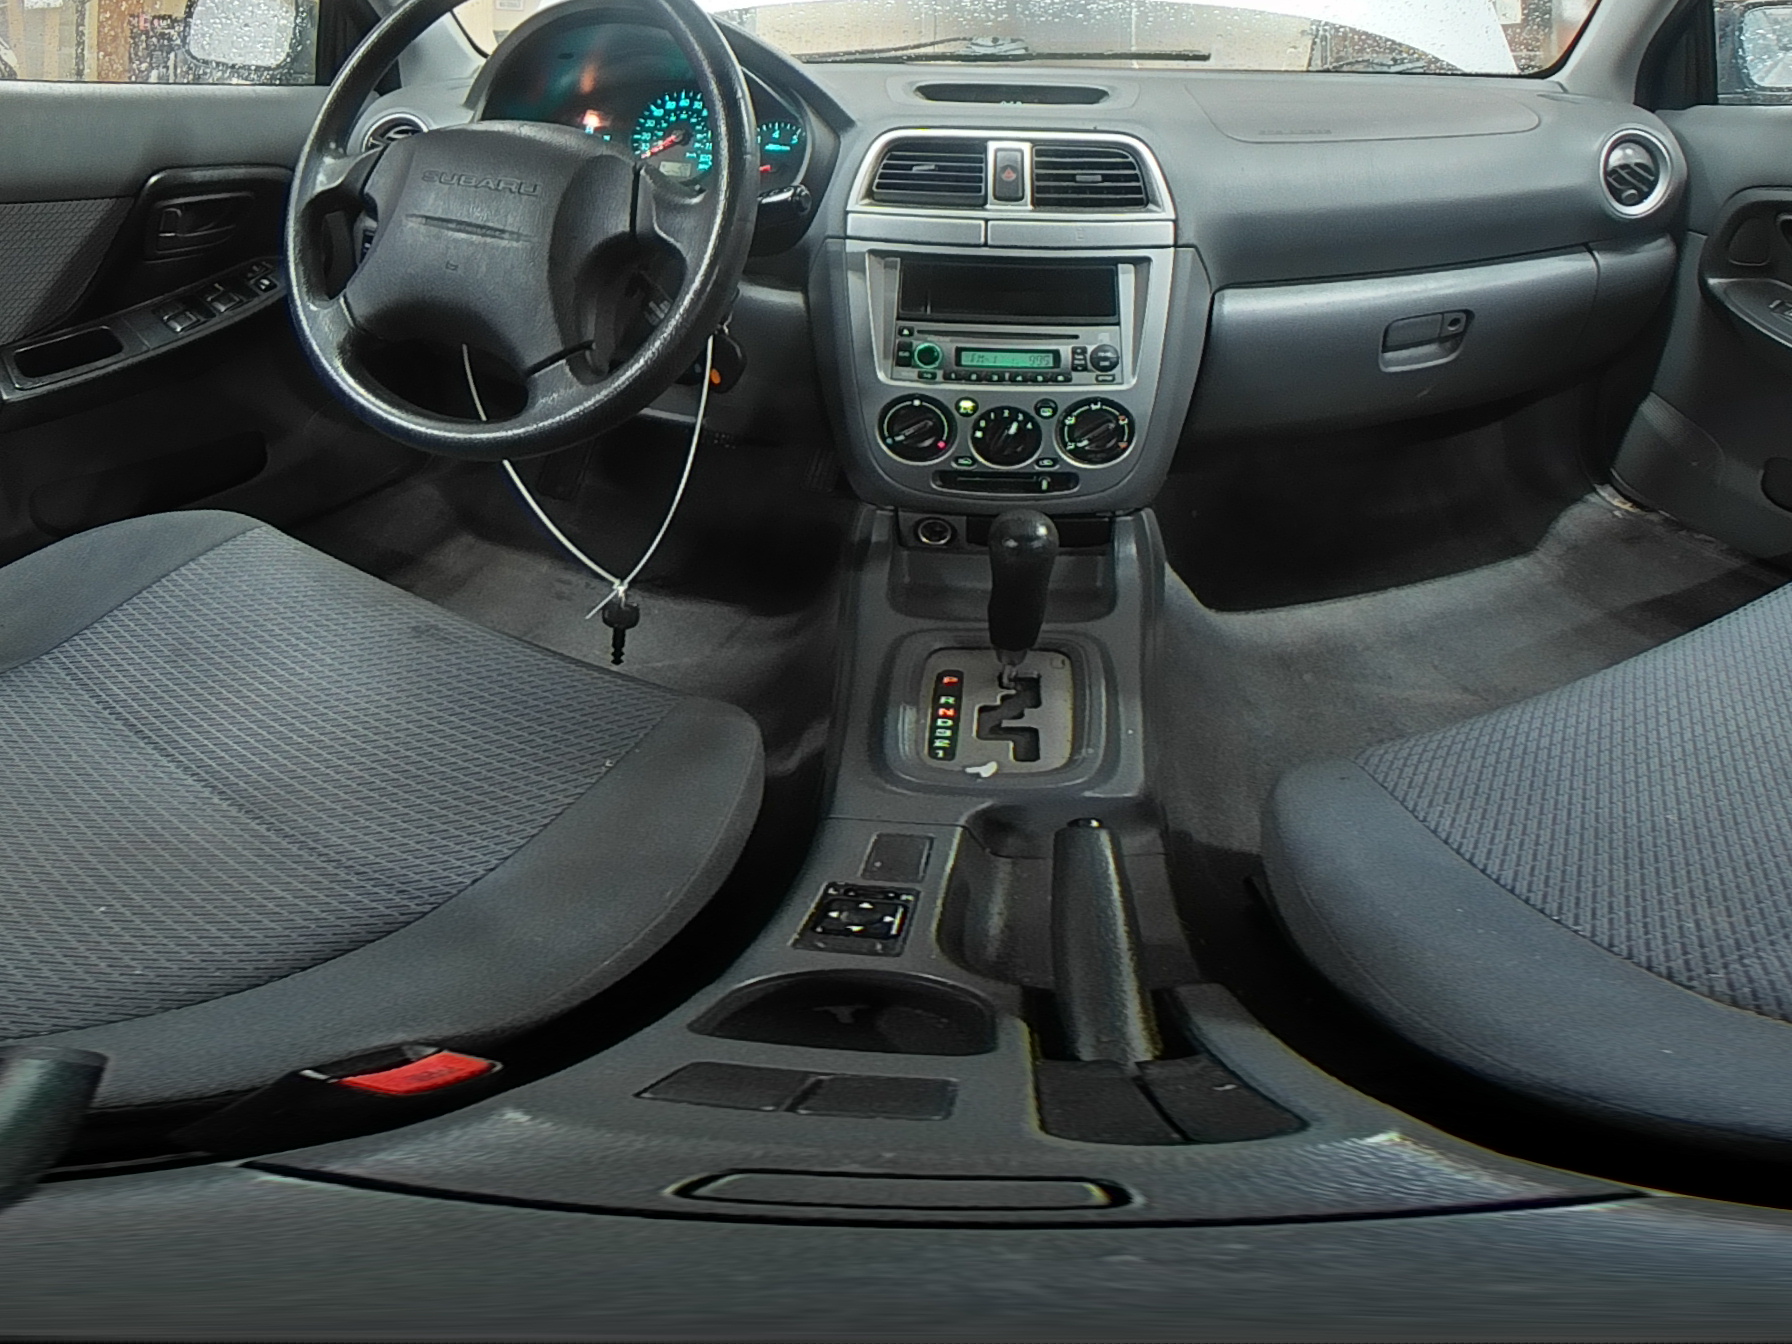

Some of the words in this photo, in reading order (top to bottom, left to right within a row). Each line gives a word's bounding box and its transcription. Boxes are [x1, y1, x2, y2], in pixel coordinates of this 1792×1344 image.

[421, 169, 543, 197] SUBARU
[942, 676, 959, 686] P
[939, 696, 956, 704] R
[938, 708, 956, 717] N
[933, 739, 950, 747] 2
[935, 750, 945, 758] 1
